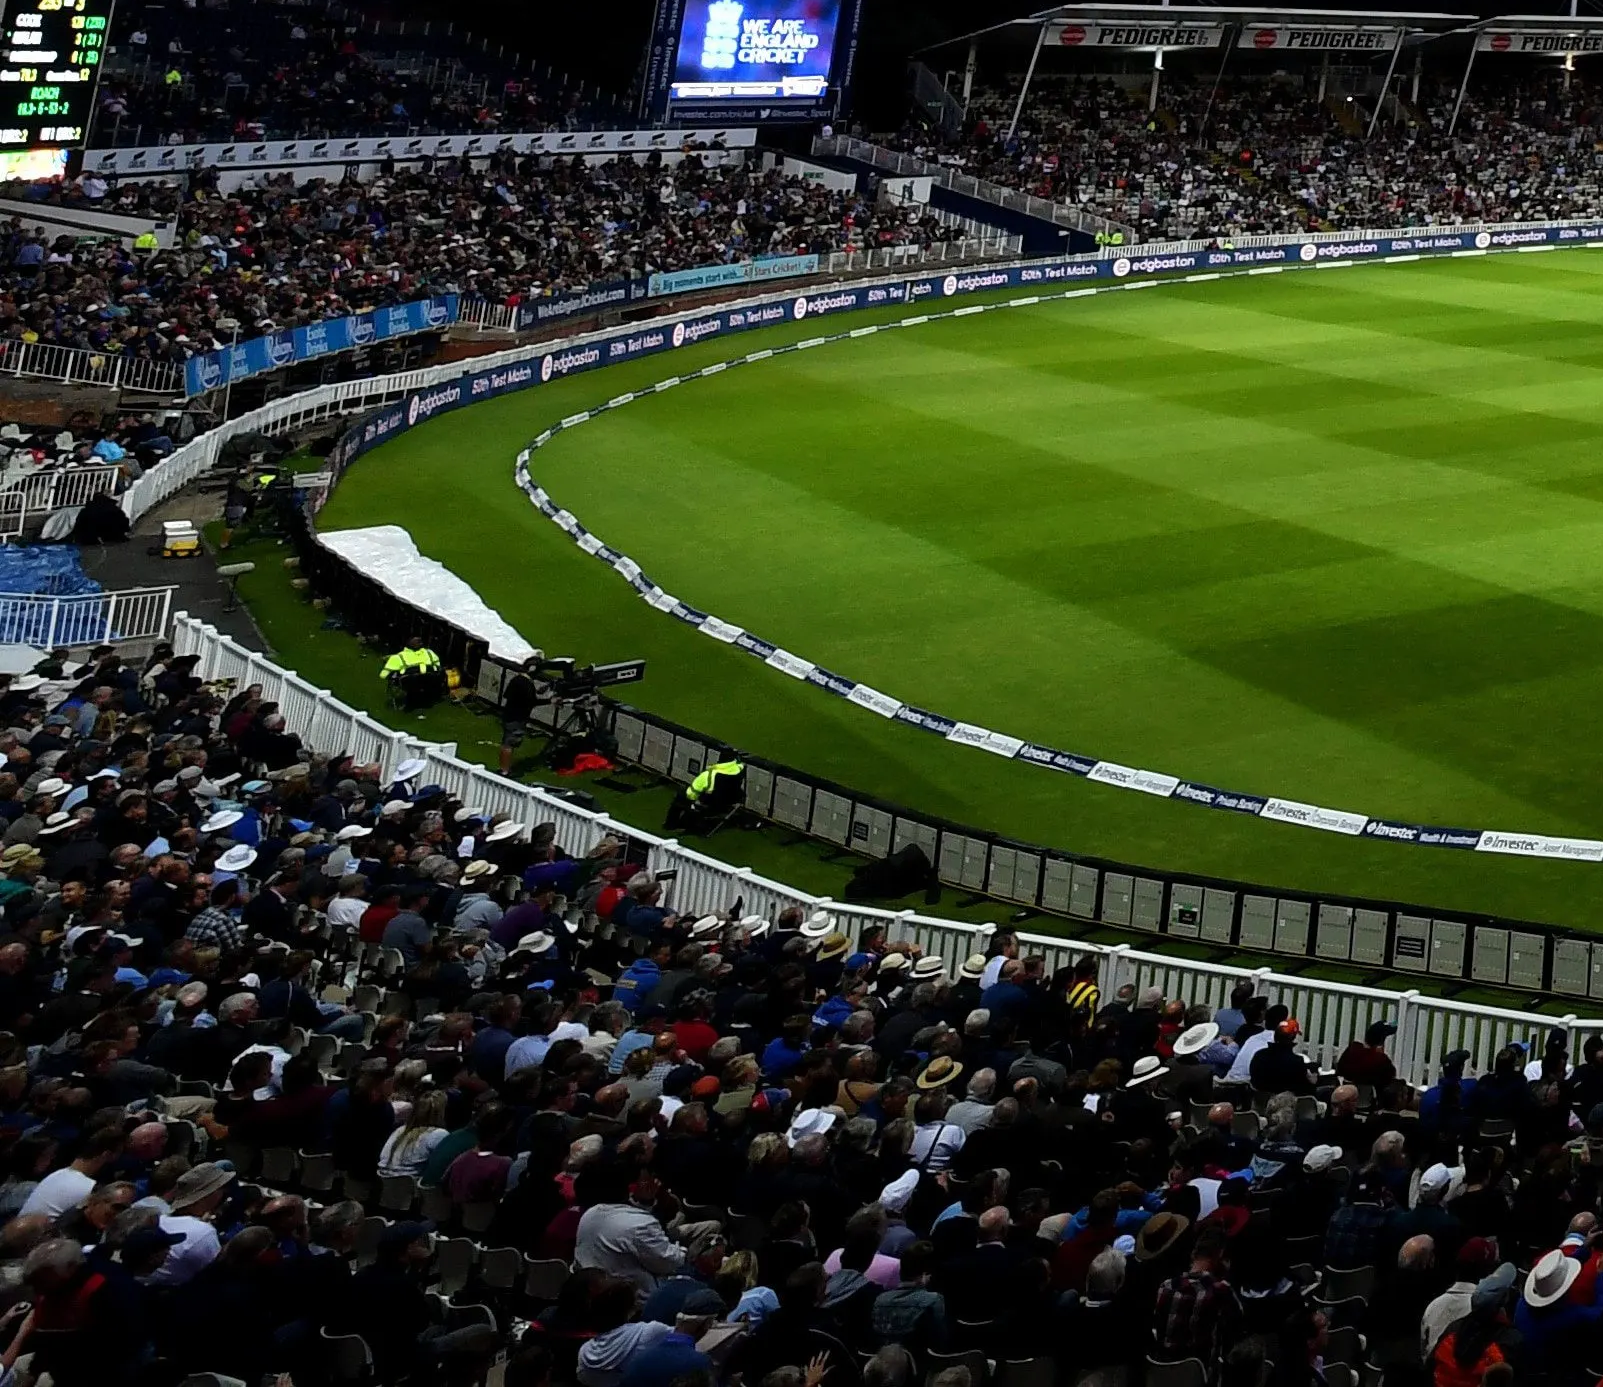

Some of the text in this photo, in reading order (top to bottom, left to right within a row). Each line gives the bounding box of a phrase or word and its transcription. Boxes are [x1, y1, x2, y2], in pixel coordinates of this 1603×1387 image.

[742, 19, 804, 34] WE ARE
[740, 34, 819, 49] ENGLAND
[1097, 28, 1197, 46] PEDIGREE
[1286, 31, 1377, 48] PEDIGREE
[1521, 36, 1603, 50] PEDIGREE
[737, 49, 806, 64] CRICKET
[1492, 232, 1546, 245] edgbaston
[1581, 227, 1599, 237] Test
[1318, 243, 1377, 258] edgbaston
[1414, 239, 1432, 249] Test
[1434, 237, 1461, 247] Match
[1132, 256, 1195, 274] edgbaston
[1234, 251, 1250, 262] Test
[1254, 250, 1285, 260] Match
[958, 273, 1008, 290] edgbaston
[1045, 267, 1065, 280] Test
[1067, 264, 1097, 276] Match
[808, 294, 856, 314] edgbaston
[554, 348, 599, 372] edgbaston
[419, 385, 460, 414] edgbaston
[1492, 837, 1539, 851] Investec
